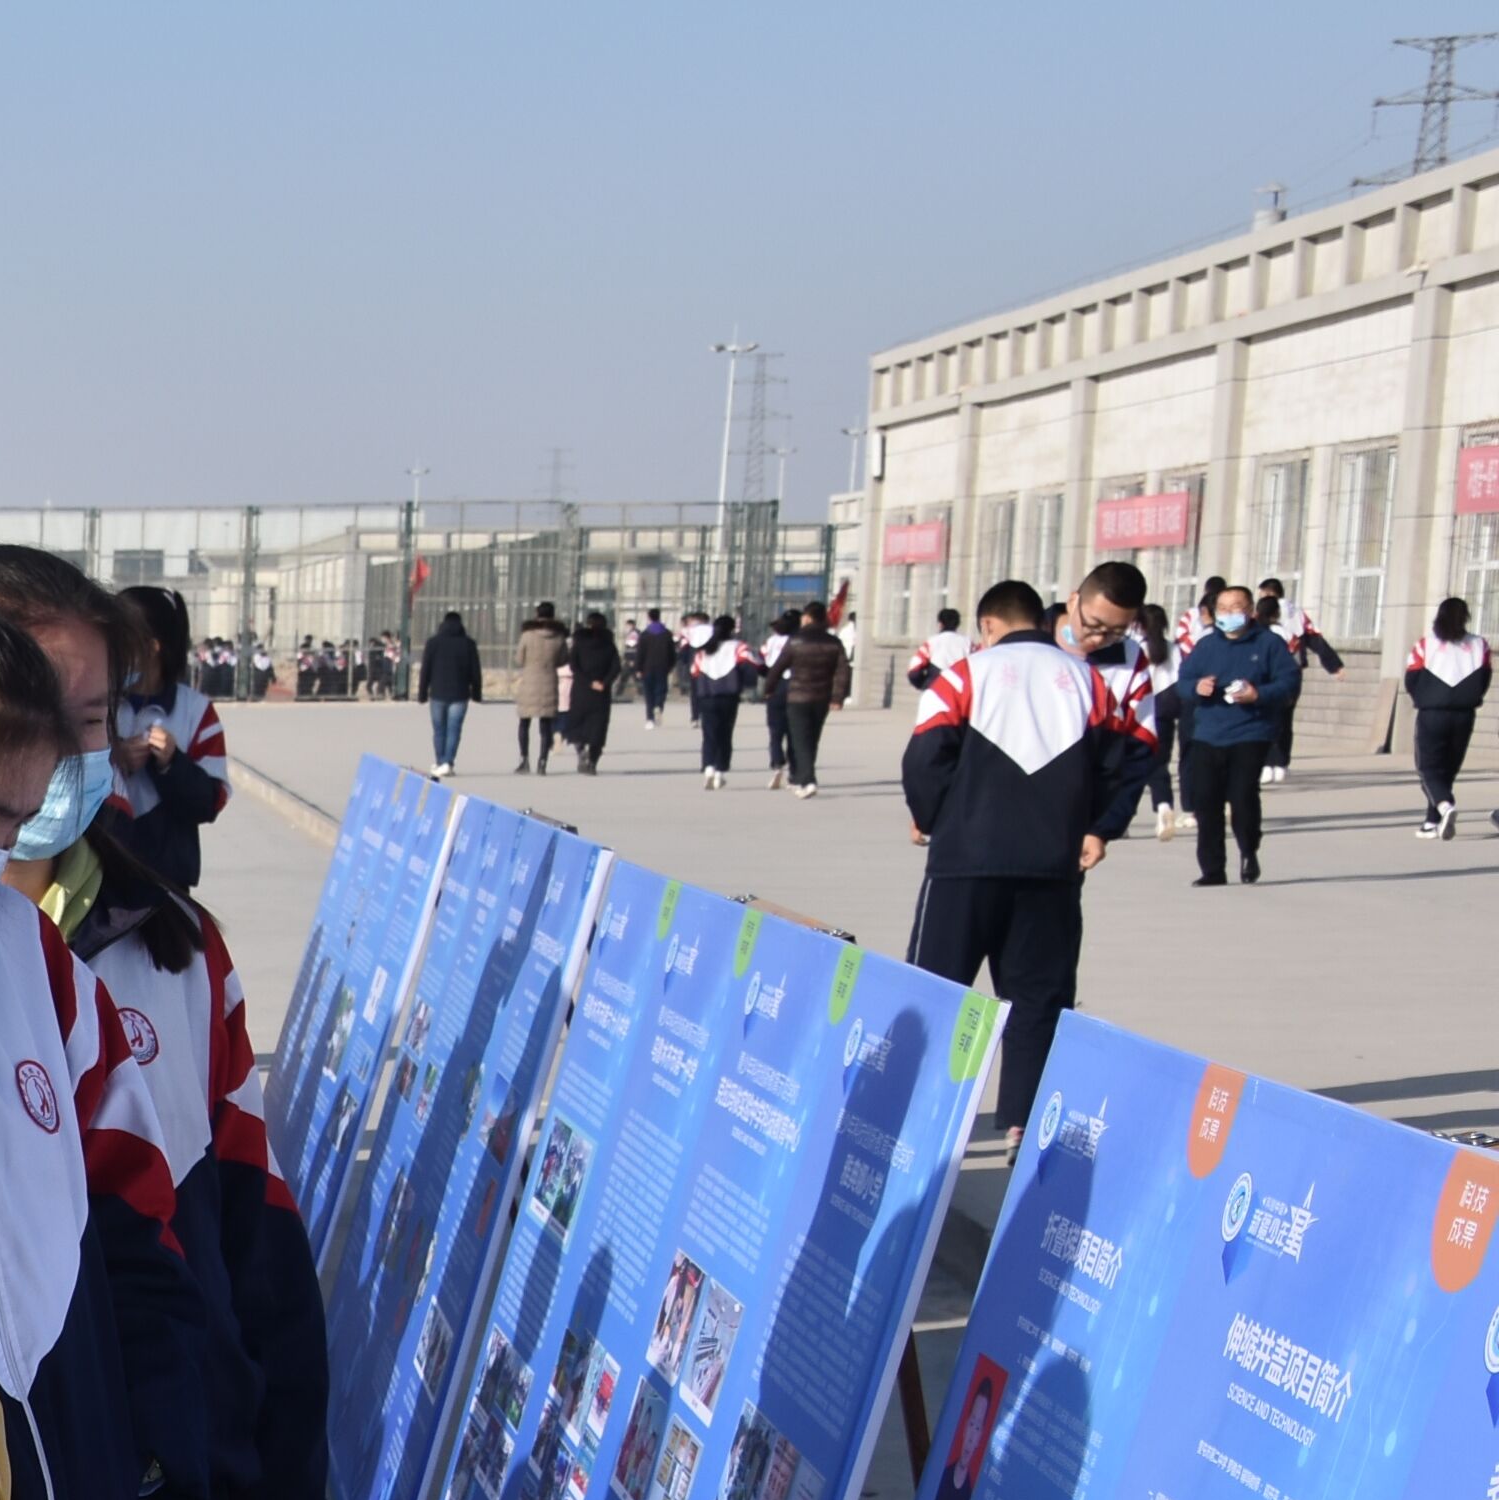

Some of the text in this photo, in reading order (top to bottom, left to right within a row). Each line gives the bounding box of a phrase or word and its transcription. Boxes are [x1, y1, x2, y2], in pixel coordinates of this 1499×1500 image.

[1206, 1086, 1229, 1114] 科技
[1199, 1116, 1221, 1144] 成果
[1458, 1179, 1490, 1214] 科技
[1446, 1216, 1478, 1250] 成果
[1222, 1311, 1353, 1424] 伸缩井盖项目简介
[1226, 1382, 1317, 1449] SCIENCE AND TECHNOLOGY
